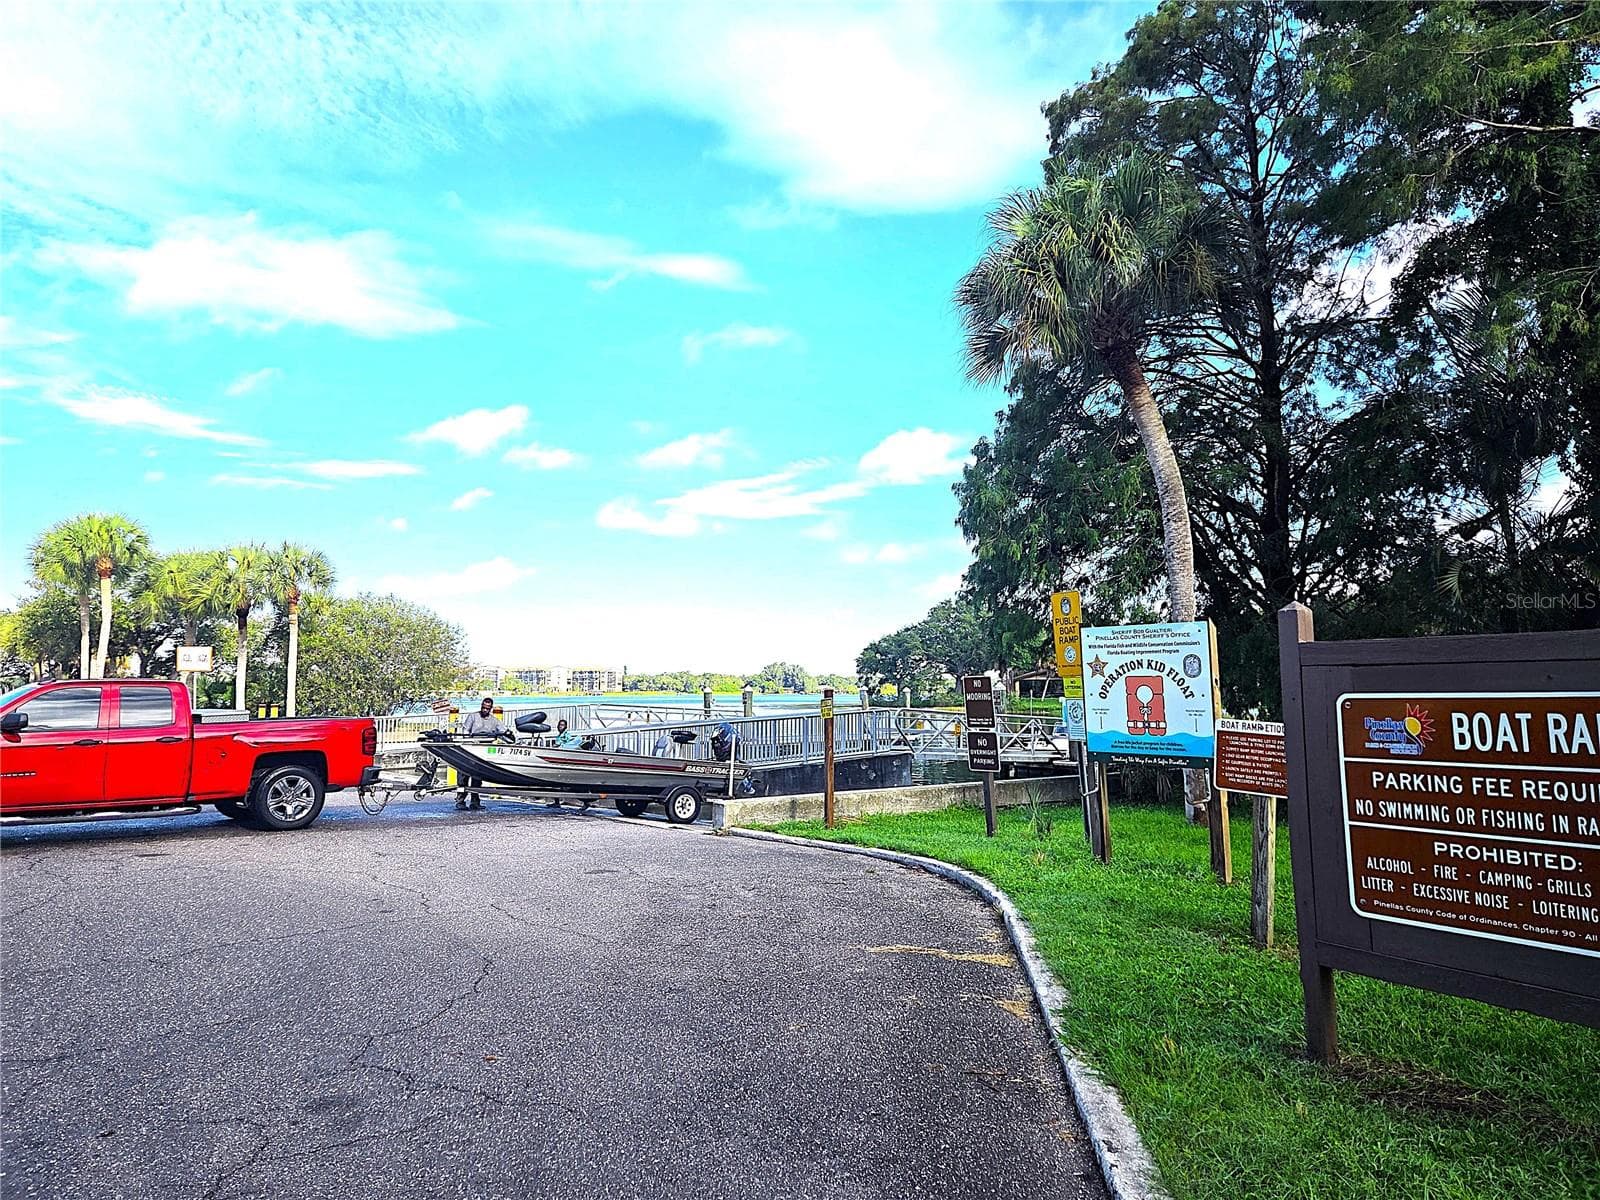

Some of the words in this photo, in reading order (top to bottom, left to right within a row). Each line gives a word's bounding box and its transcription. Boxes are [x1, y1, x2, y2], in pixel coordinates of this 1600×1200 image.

[1055, 616, 1079, 626] PUBLIC
[1059, 626, 1076, 635] BOAT
[1059, 635, 1078, 644] RAMP
[1098, 659, 1144, 700] OPERATION
[1146, 659, 1166, 673] KID
[1166, 667, 1195, 699] FLOAT
[966, 692, 991, 701] MOORING
[1221, 720, 1239, 729] BOAT
[1242, 722, 1262, 731] RAMP
[1451, 712, 1532, 753] BOAT
[1546, 713, 1600, 755] RA
[711, 767, 745, 776] TRACER
[1372, 771, 1463, 794] PARKING
[1472, 777, 1514, 798] FEE
[1522, 780, 1600, 803] REQUI
[1355, 799, 1373, 816] NO
[1378, 801, 1450, 823] SWIMMING
[1456, 807, 1475, 825] OR
[1481, 808, 1545, 832] FISHING
[1552, 814, 1569, 834] IN
[1434, 842, 1582, 872] PROHIBITED:
[1366, 856, 1414, 875] ALCOHOL
[1434, 864, 1458, 880] FIRE
[1479, 870, 1532, 890] CAMPING
[1547, 879, 1592, 898] GRILLS
[1361, 875, 1394, 892] LITTER
[1413, 883, 1471, 904] EXCESSIVE
[1474, 892, 1510, 910] NOISE
[1532, 900, 1599, 923] LOITERING
[1374, 900, 1404, 911] Pinellas
[1406, 905, 1434, 916] County
[1436, 910, 1456, 919] Code
[1522, 924, 1559, 935] Chapter
[1584, 933, 1598, 942] All
